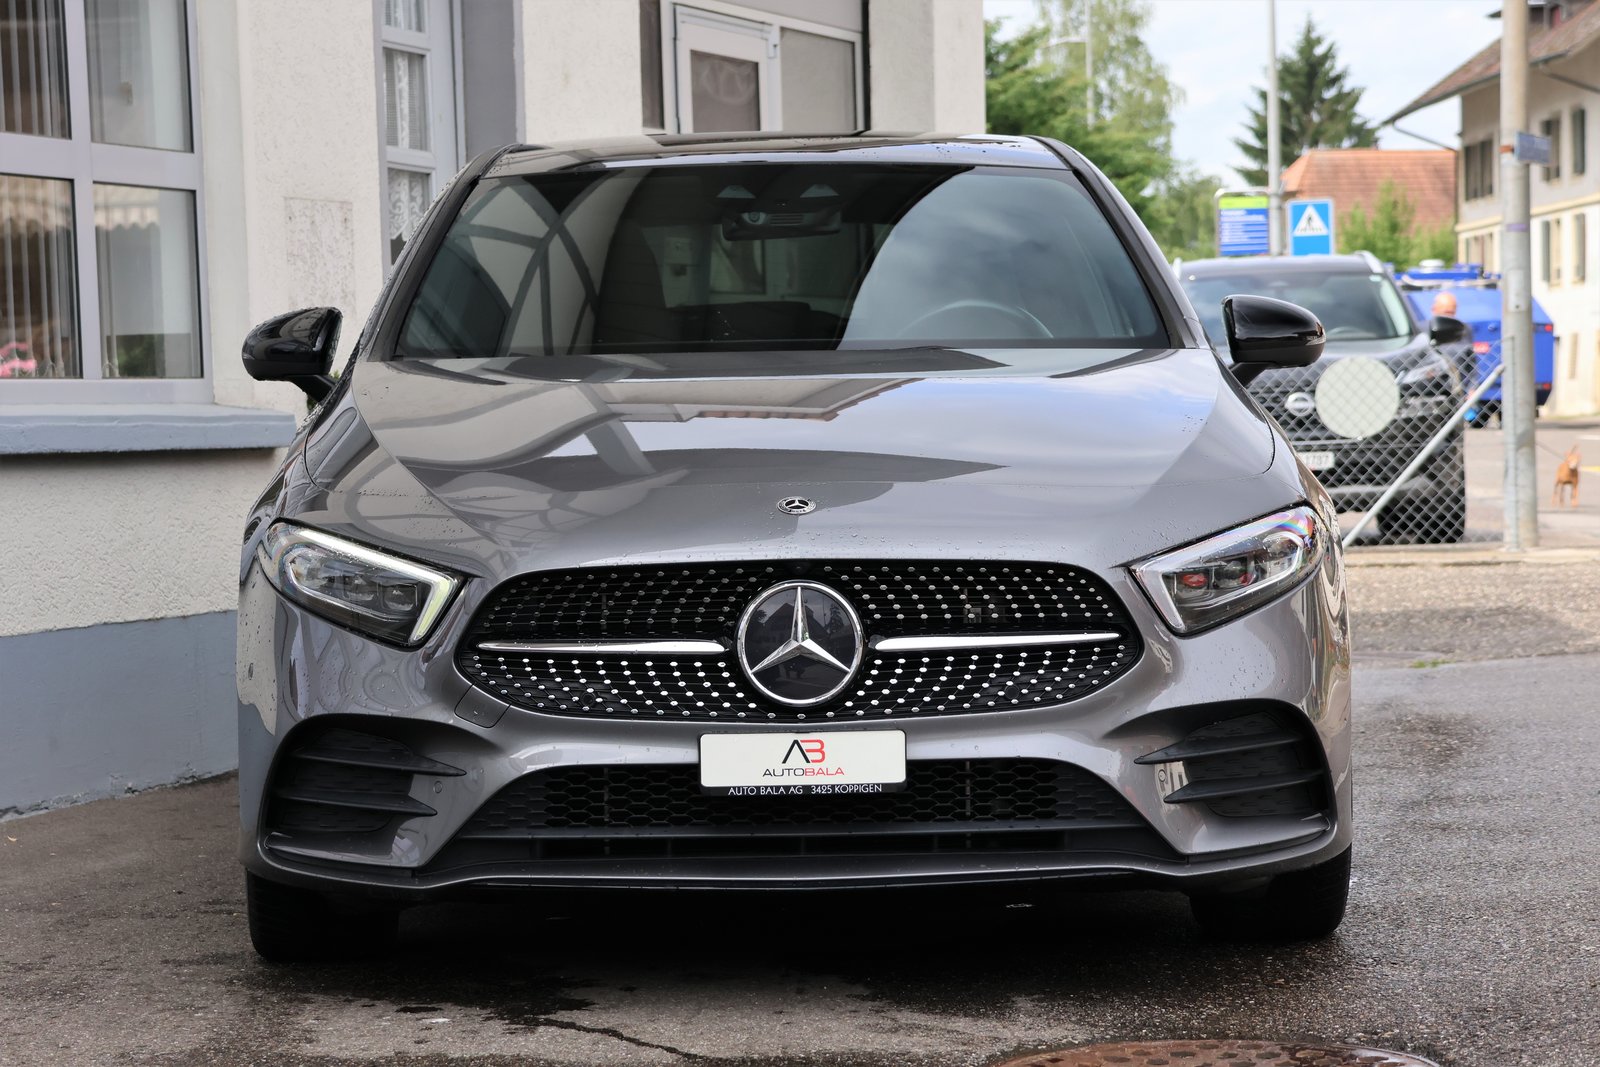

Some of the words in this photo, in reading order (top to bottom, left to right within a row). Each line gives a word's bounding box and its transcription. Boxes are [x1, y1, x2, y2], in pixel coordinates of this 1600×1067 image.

[762, 767, 845, 777] AUTOBALA
[728, 786, 757, 796] AUTO
[760, 785, 786, 795] BALA
[788, 785, 803, 795] AG
[811, 784, 832, 794] 3425
[834, 783, 883, 794] KOPPIGEN
